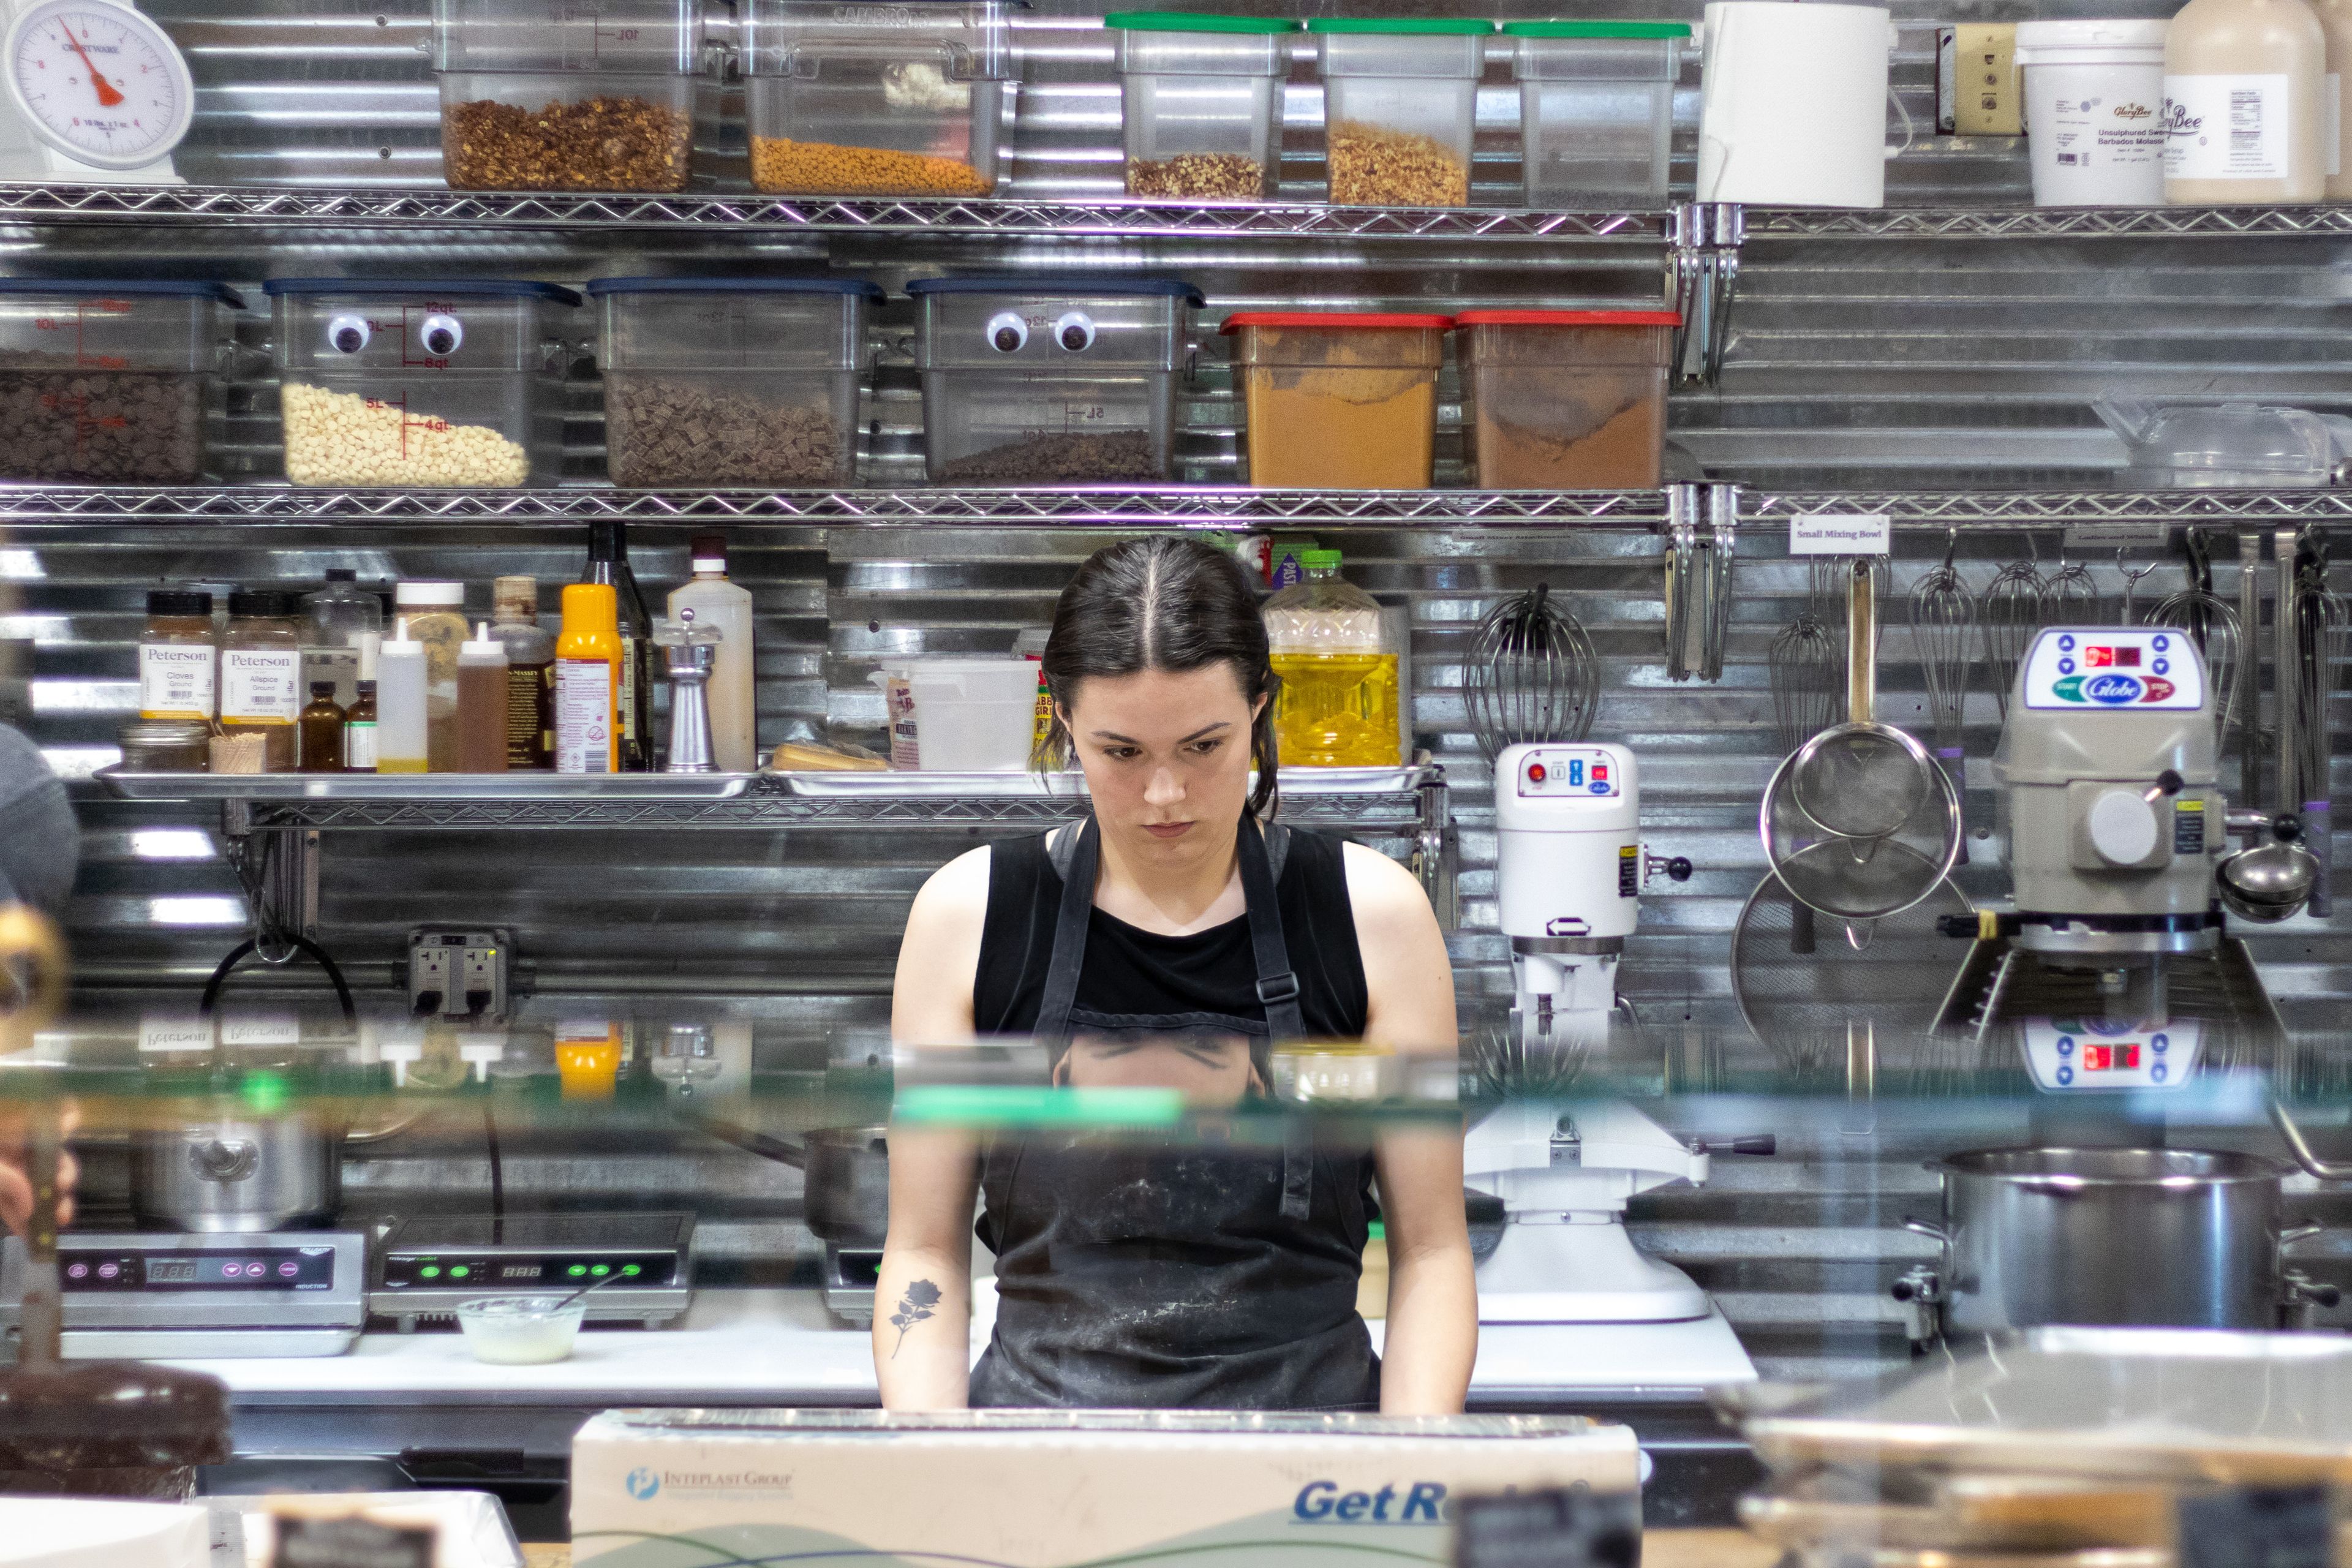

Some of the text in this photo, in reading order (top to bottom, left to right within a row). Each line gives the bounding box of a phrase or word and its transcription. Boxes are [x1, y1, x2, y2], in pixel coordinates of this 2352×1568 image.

[2114, 105, 2152, 119] GloryBee
[425, 302, 457, 314] 12qt.
[366, 398, 383, 409] 5L
[1825, 530, 1857, 540] Mixing
[1283, 562, 1297, 585] PAST
[148, 649, 207, 661] Peterson
[232, 655, 290, 666] Peterson
[2089, 678, 2138, 697] Globe
[1036, 696, 1052, 706] ABB
[665, 1471, 792, 1485] INTEPLAST GROUP
[1294, 1480, 1396, 1520] Get
